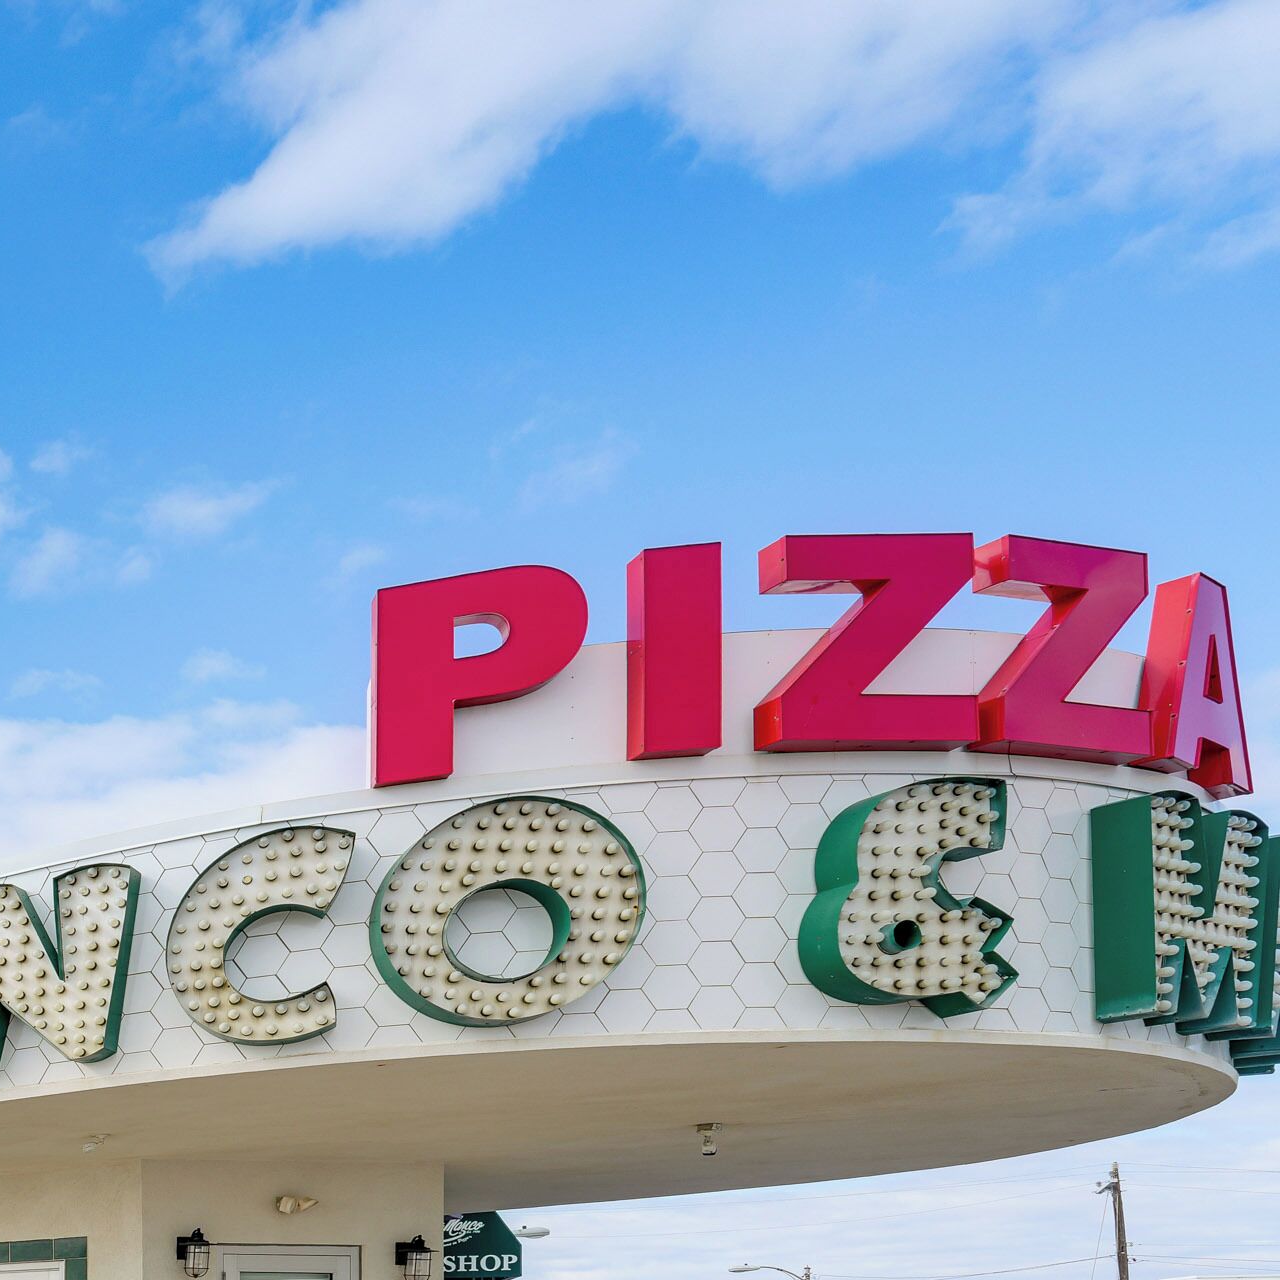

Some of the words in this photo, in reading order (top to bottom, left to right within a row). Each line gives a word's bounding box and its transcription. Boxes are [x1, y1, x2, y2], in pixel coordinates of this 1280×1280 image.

[370, 531, 1254, 797] PIZZA
[798, 777, 1015, 1017] &
[443, 1254, 518, 1273] SHOP
